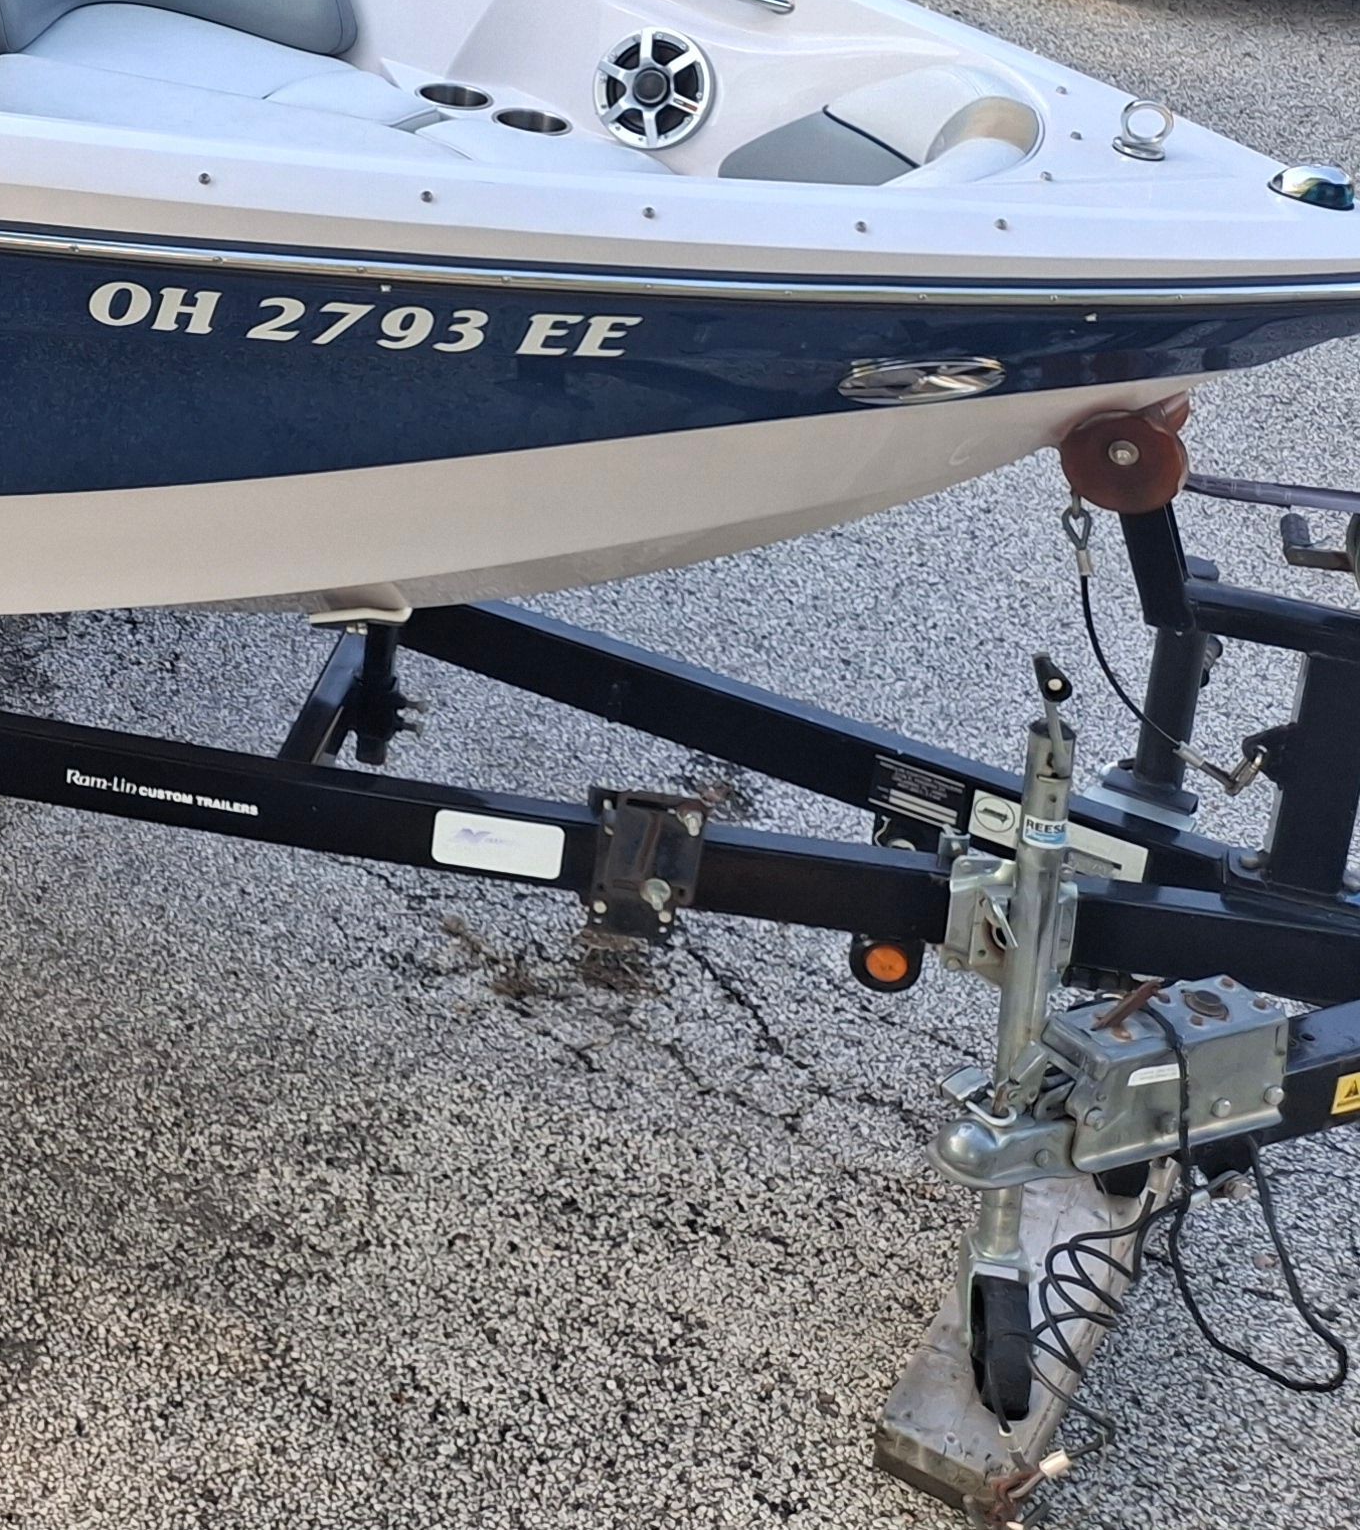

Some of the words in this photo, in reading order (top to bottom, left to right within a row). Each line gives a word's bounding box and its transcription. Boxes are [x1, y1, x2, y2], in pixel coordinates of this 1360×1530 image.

[87, 280, 223, 336] OH
[244, 296, 489, 354] 2793
[515, 313, 644, 359] EE
[66, 768, 137, 795] Ram-Lin
[138, 786, 194, 806] CUSTOM
[196, 795, 260, 817] TRAILERS
